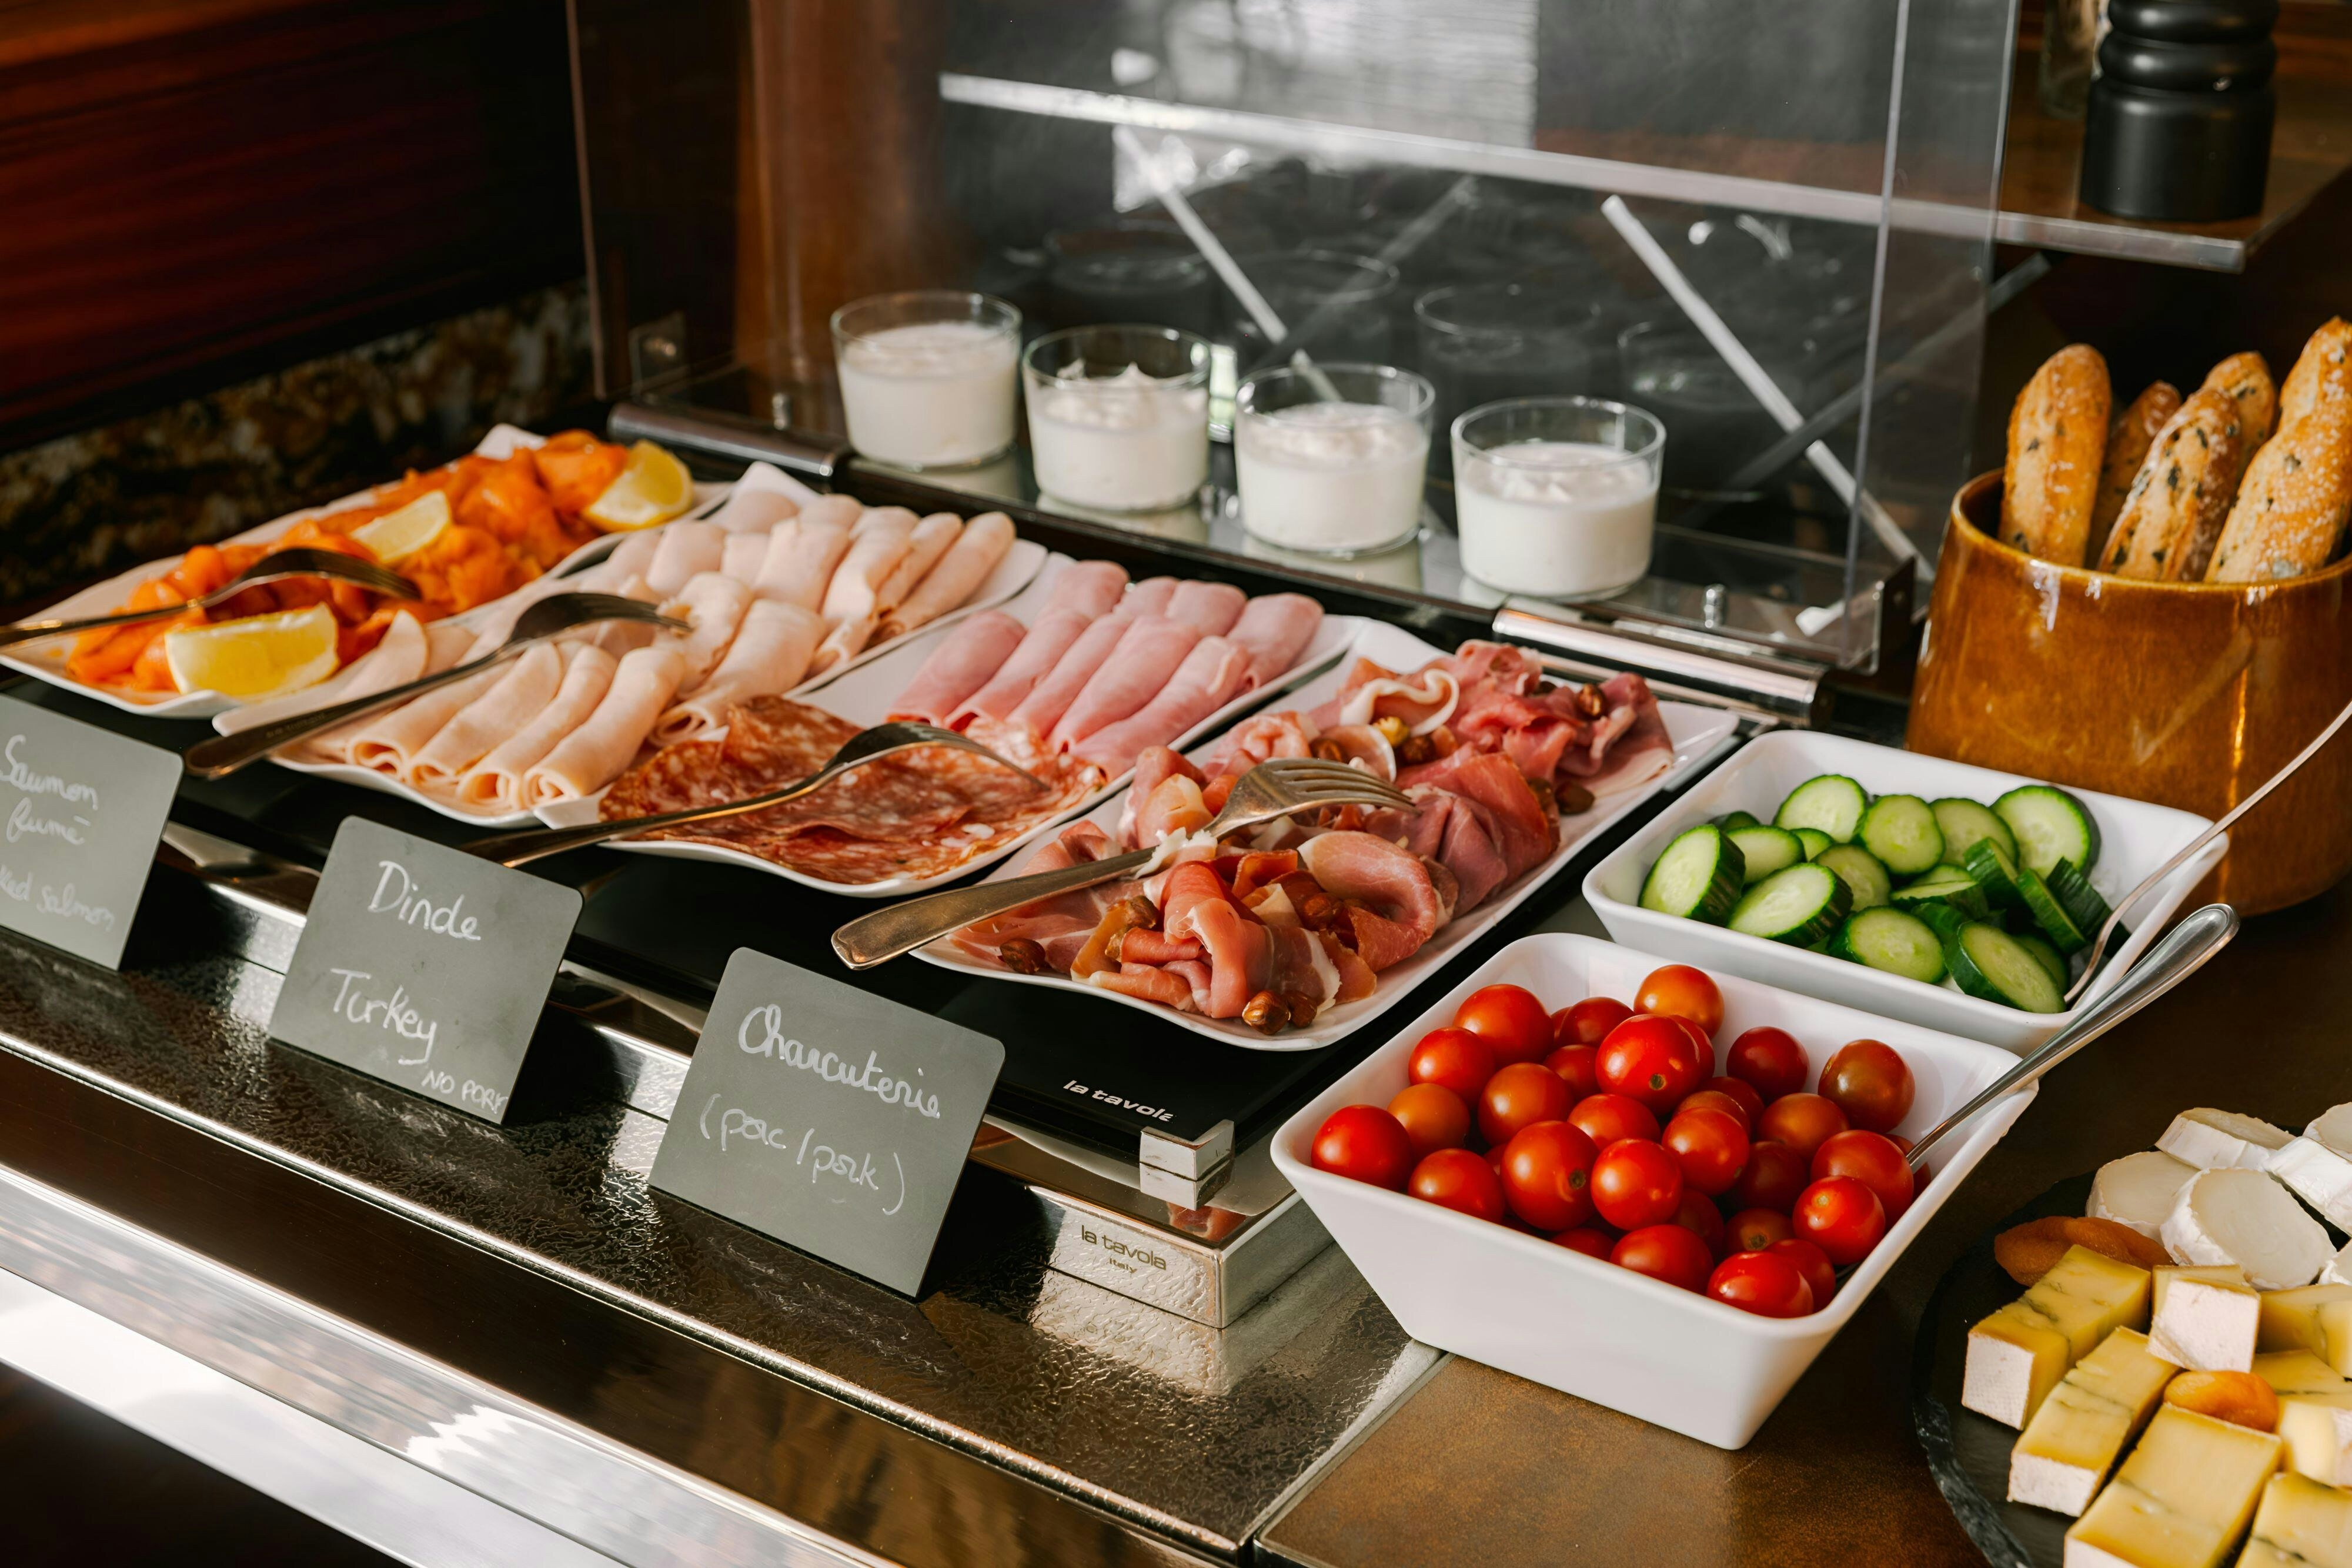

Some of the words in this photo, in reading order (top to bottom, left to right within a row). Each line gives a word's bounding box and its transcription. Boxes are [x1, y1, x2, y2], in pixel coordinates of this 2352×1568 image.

[0, 734, 99, 810] Saumon
[368, 860, 482, 941] Dinde
[330, 968, 437, 1065] Turkey
[421, 1069, 455, 1094] NO
[738, 1003, 941, 1119] Charcuterie
[1063, 1079, 1090, 1095] la
[1081, 1225, 1097, 1245] la
[1101, 1235, 1167, 1271] tavola
